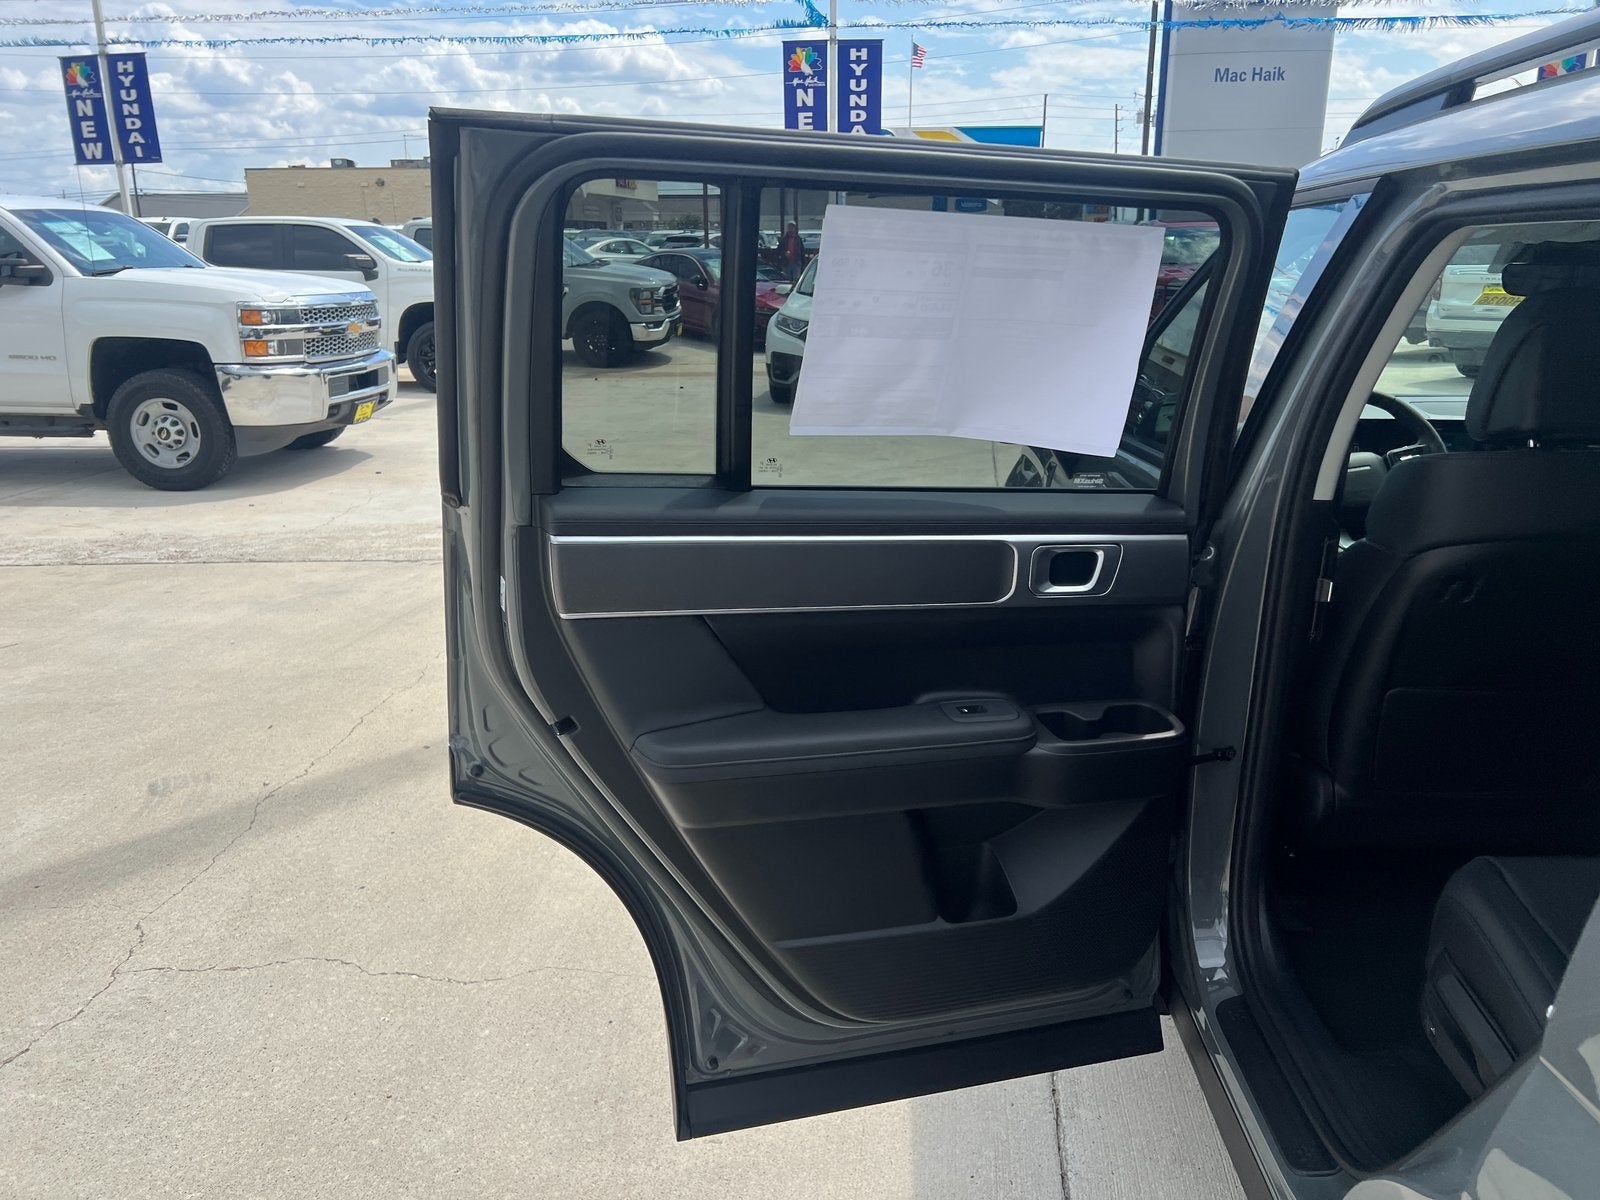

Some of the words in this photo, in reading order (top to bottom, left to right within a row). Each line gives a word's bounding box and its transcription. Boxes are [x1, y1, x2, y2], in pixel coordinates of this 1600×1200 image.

[848, 47, 869, 135] HYUNDA
[1213, 67, 1248, 83] Mac
[1251, 66, 1287, 82] Haik
[75, 99, 103, 160] NEW
[116, 60, 146, 158] HYUNDAI
[795, 87, 815, 131] NE
